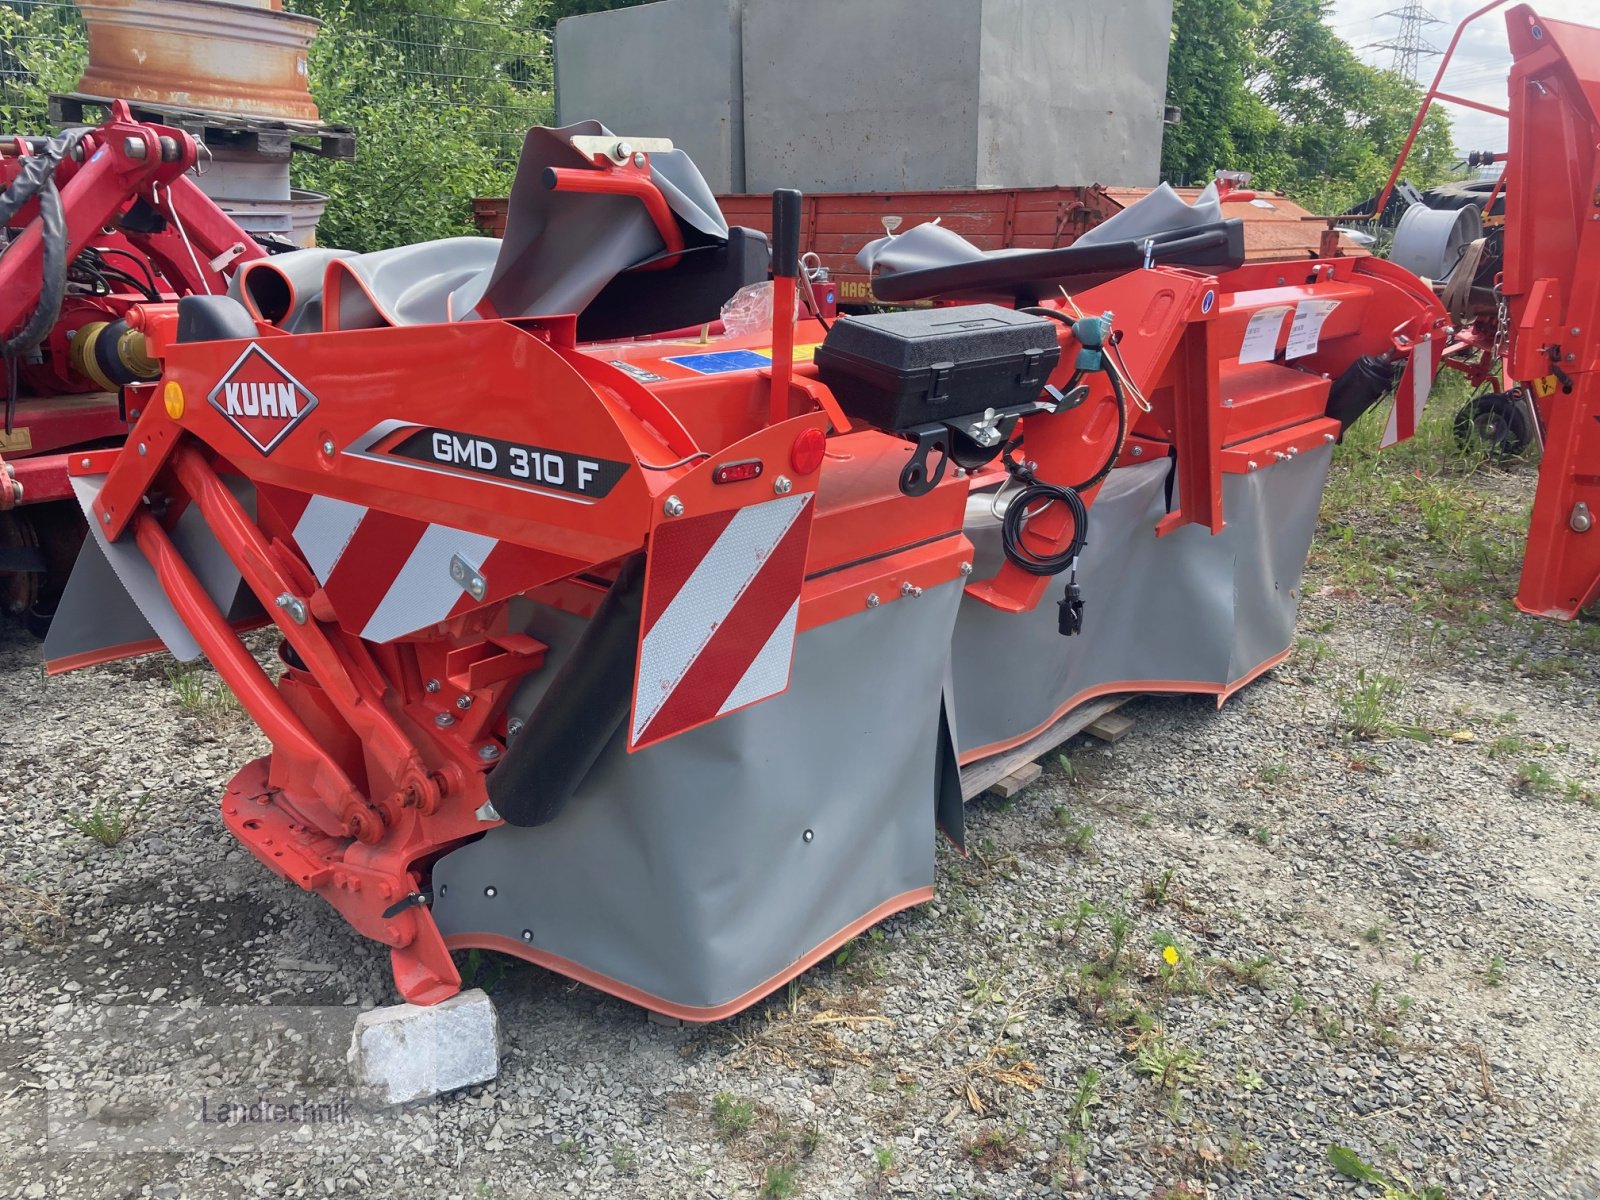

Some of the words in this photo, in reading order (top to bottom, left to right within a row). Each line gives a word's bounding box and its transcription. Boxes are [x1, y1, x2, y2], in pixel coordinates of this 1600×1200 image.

[225, 382, 298, 418] KUHN
[432, 432, 498, 471] GMD
[509, 447, 565, 486] 310
[577, 459, 600, 490] F
